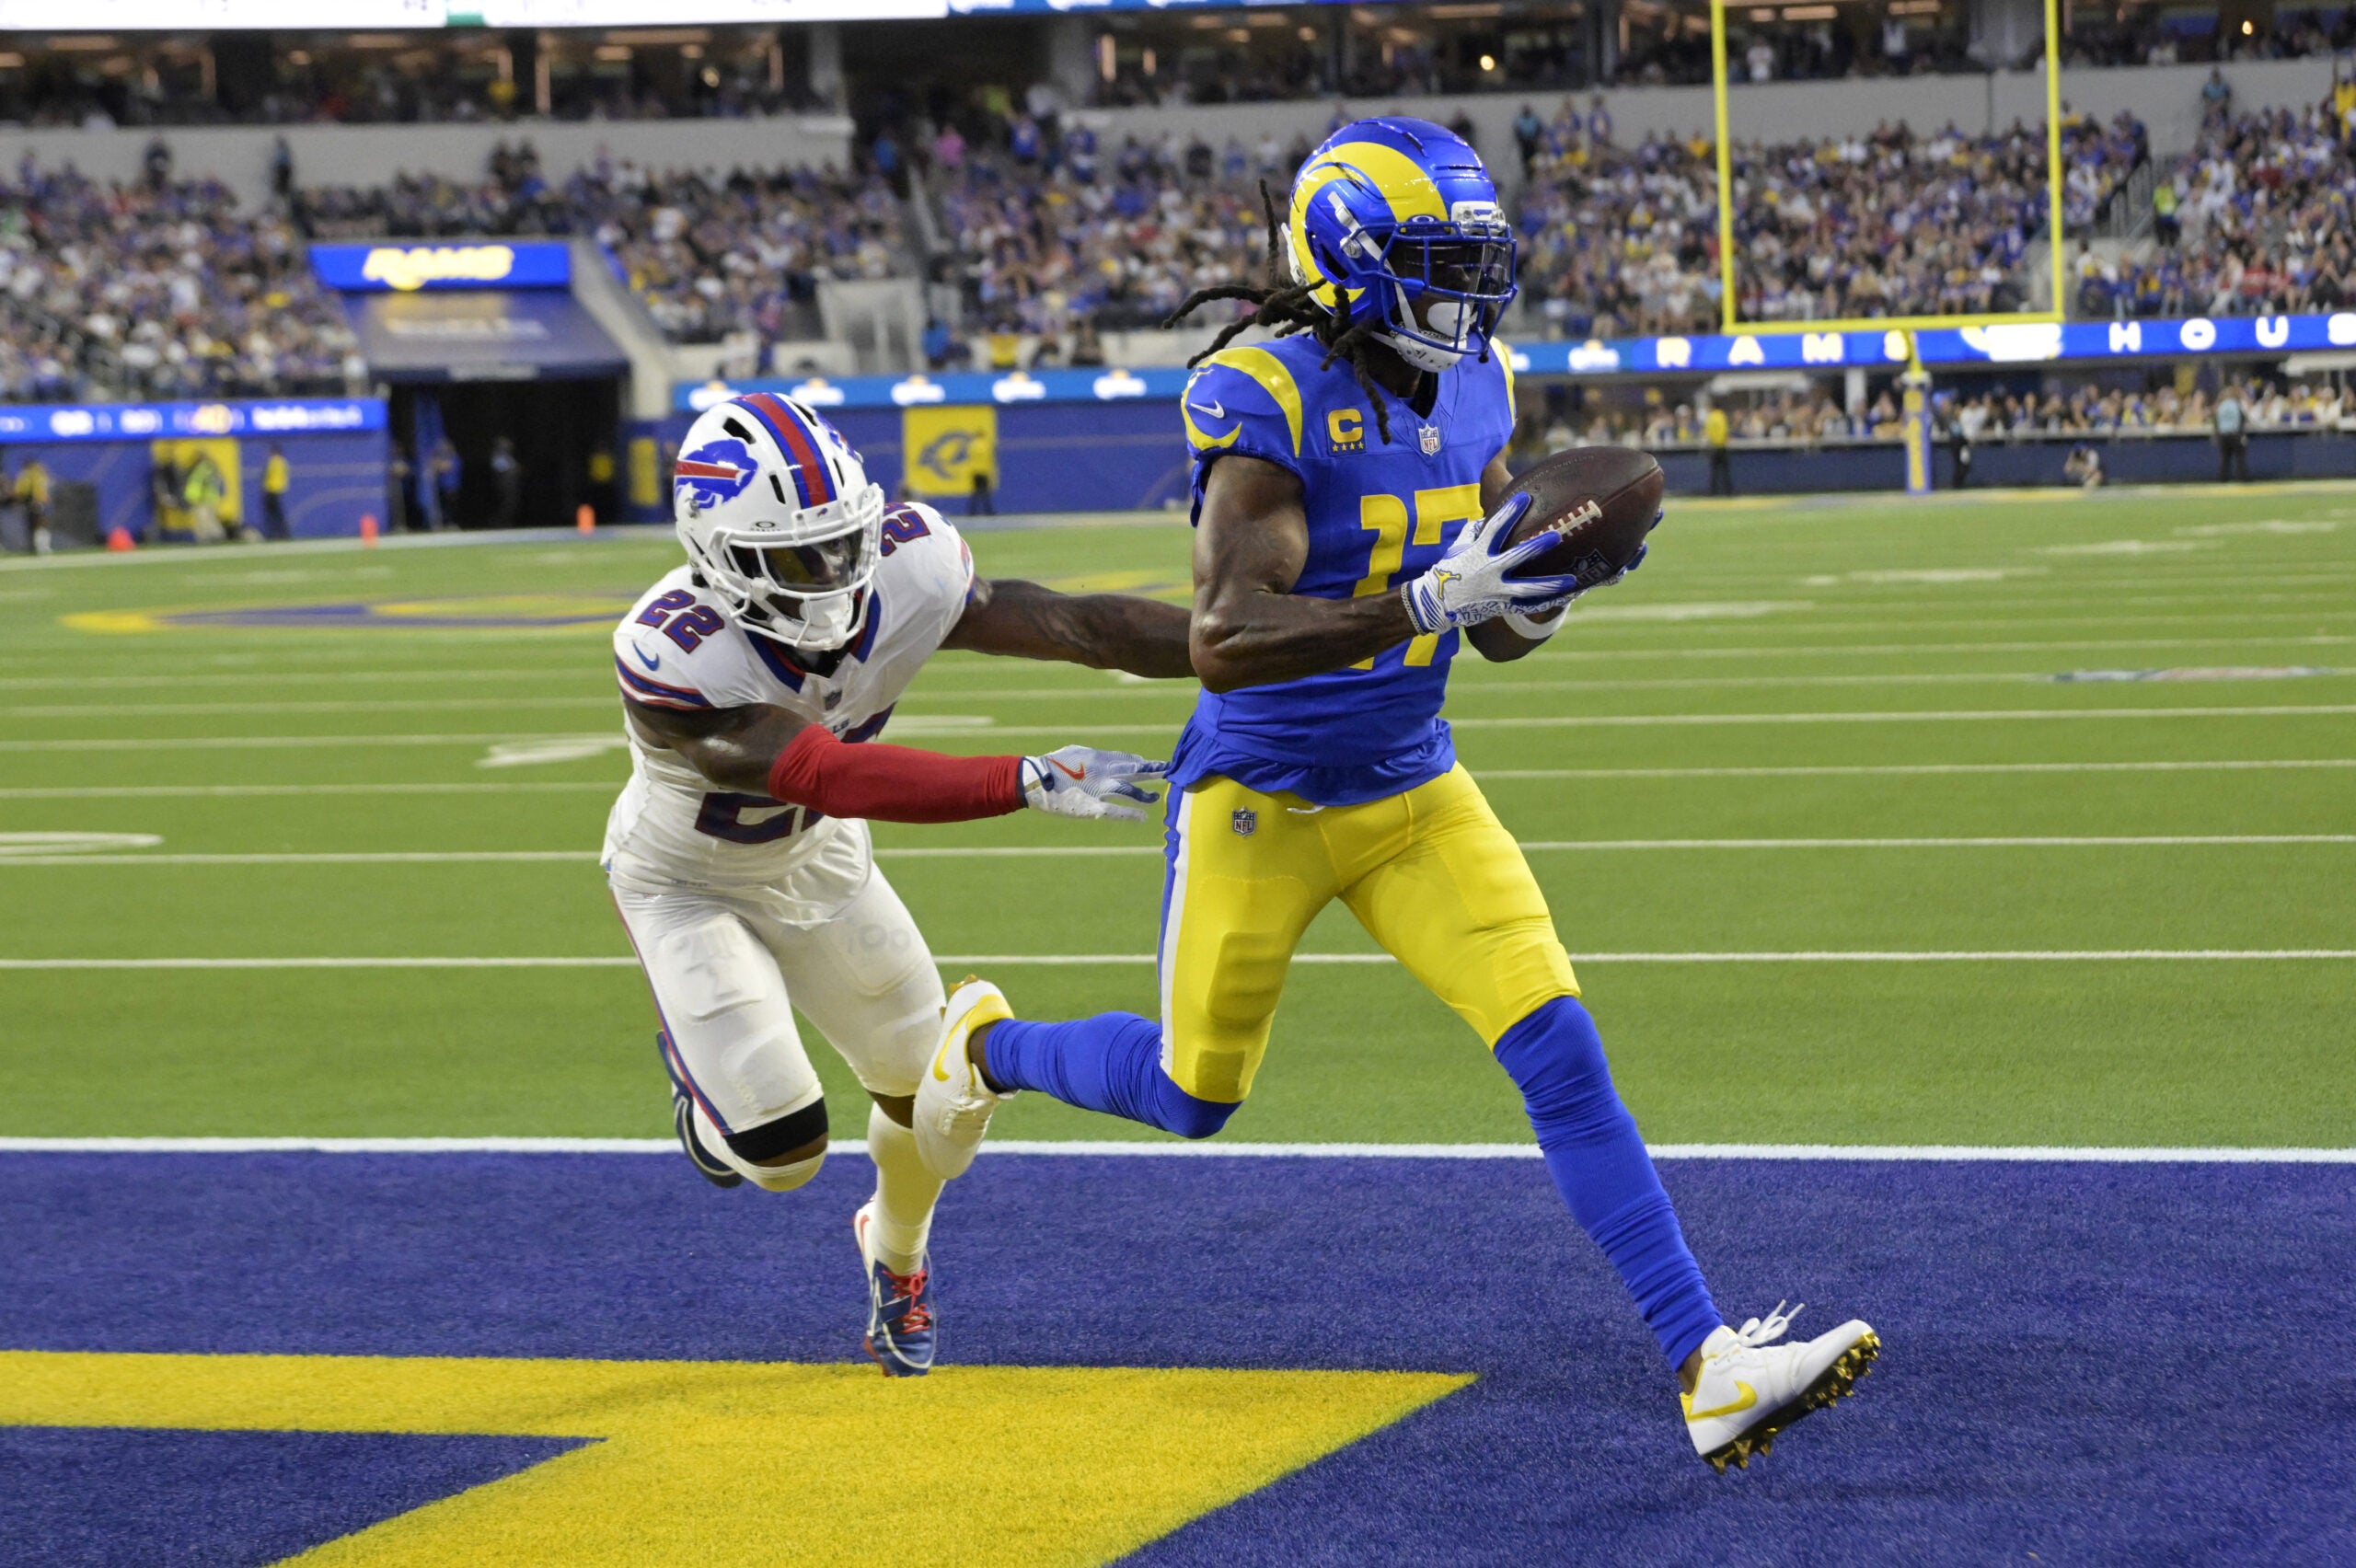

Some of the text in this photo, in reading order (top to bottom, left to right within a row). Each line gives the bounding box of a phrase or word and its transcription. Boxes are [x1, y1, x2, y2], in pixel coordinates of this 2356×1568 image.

[1327, 408, 1364, 444] C
[1423, 437, 1438, 451] NFL
[1348, 482, 1484, 670] 17
[636, 589, 724, 654] 22
[1235, 820, 1252, 832] NFL
